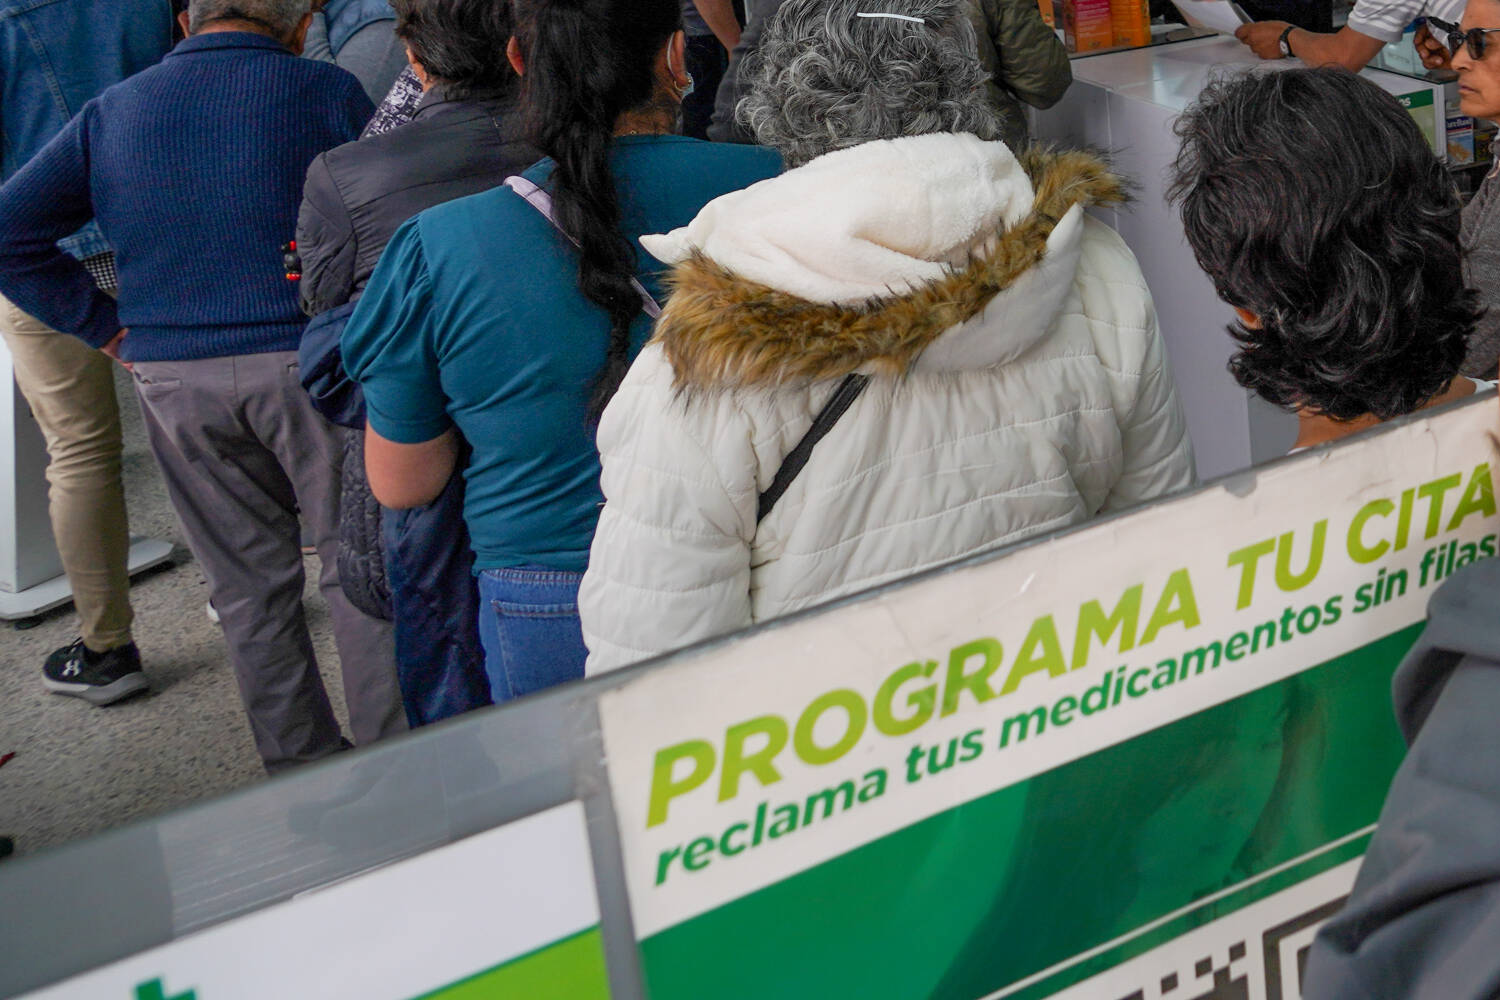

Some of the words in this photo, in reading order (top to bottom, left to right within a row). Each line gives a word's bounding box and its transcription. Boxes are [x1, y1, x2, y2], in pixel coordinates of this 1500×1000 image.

[644, 565, 1201, 829] PROGRAMA
[1226, 520, 1328, 610] TU
[1345, 461, 1498, 563] CITA
[653, 766, 887, 888] reclama
[904, 727, 985, 782] tus
[997, 596, 1341, 749] medicamentos
[1351, 563, 1408, 617] sin
[1417, 532, 1498, 588] filas
